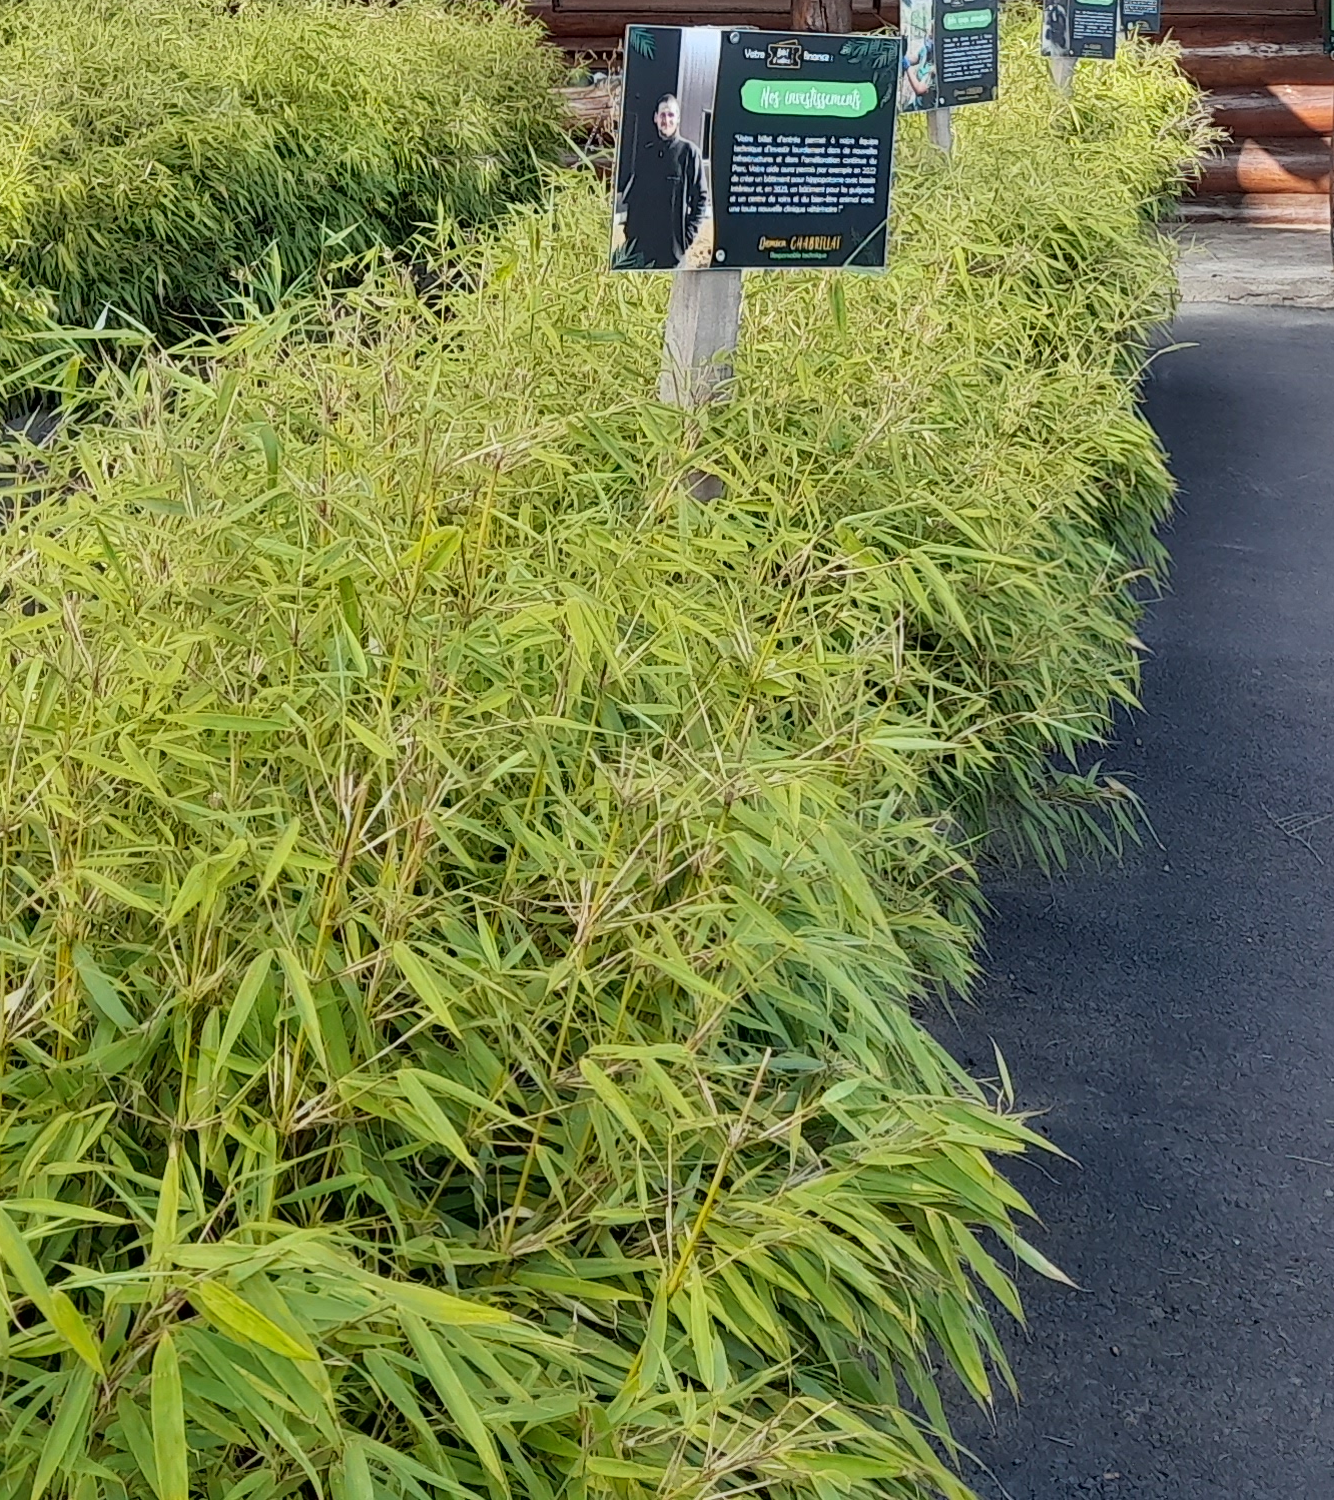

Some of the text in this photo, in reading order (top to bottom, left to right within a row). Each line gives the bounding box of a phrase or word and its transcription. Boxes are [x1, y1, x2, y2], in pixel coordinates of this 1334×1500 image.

[744, 48, 765, 59] Votre
[760, 86, 861, 111] Nos investissements
